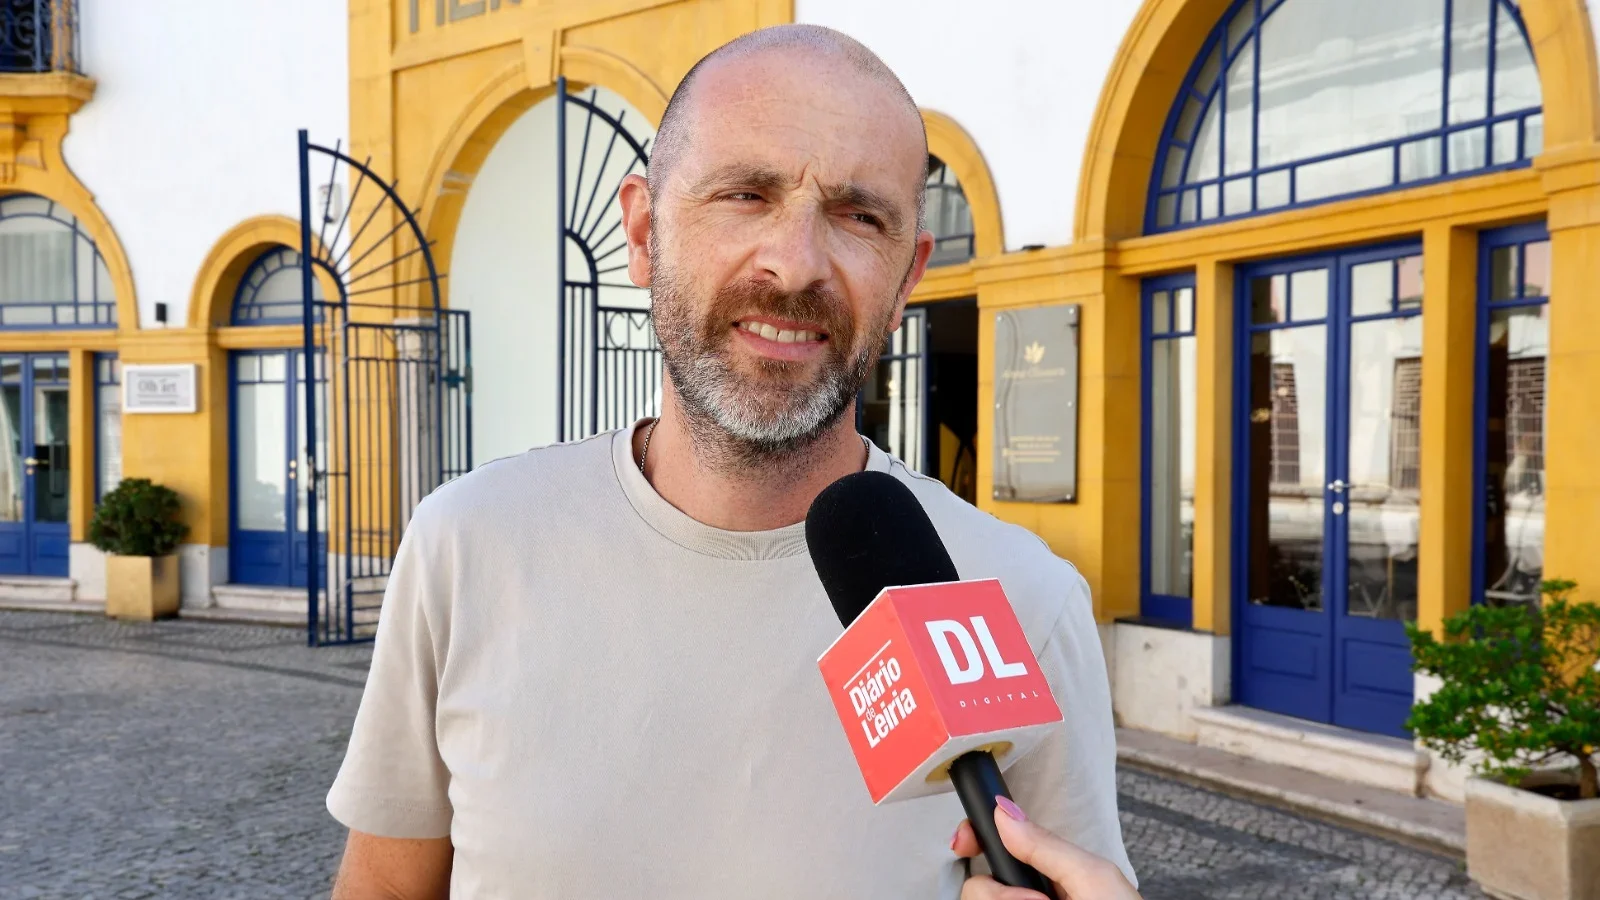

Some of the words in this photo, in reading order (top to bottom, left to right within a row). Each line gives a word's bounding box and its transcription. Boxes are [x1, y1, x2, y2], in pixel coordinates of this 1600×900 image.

[924, 615, 1028, 685] DL
[848, 657, 902, 718] Diário
[860, 687, 918, 749] Leiria
[865, 706, 876, 722] de
[959, 690, 1039, 708] DIGITAL
